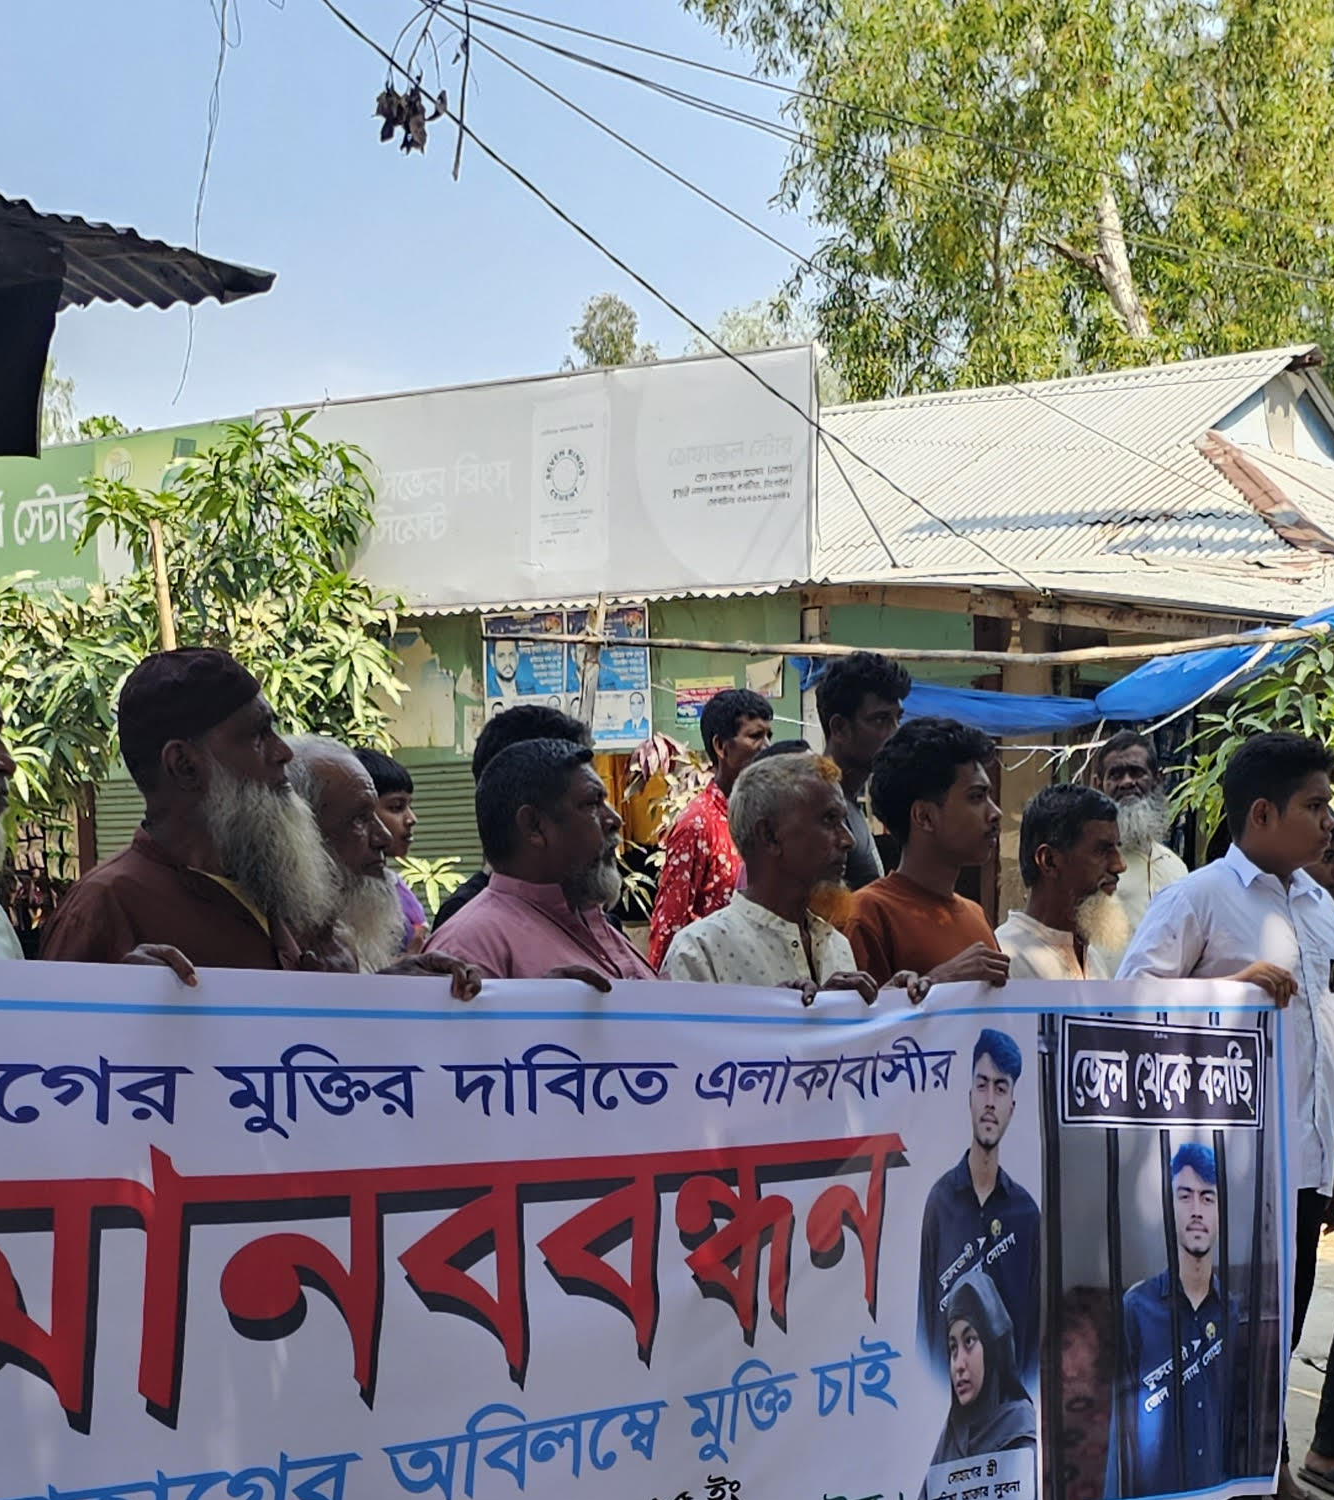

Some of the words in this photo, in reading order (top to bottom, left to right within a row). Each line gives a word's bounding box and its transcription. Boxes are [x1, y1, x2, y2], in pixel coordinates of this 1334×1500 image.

[13, 483, 89, 546] স্টোর
[213, 1043, 424, 1139] মুক্তির
[440, 1043, 677, 1116] দাবিতে
[694, 1035, 959, 1109] এলাকাবাসীর
[1071, 1049, 1130, 1109] জেল
[1134, 1052, 1194, 1112] থেকে
[1195, 1039, 1256, 1116] বলছি
[682, 1359, 798, 1463] মুক্তি
[810, 1336, 902, 1418] চাই
